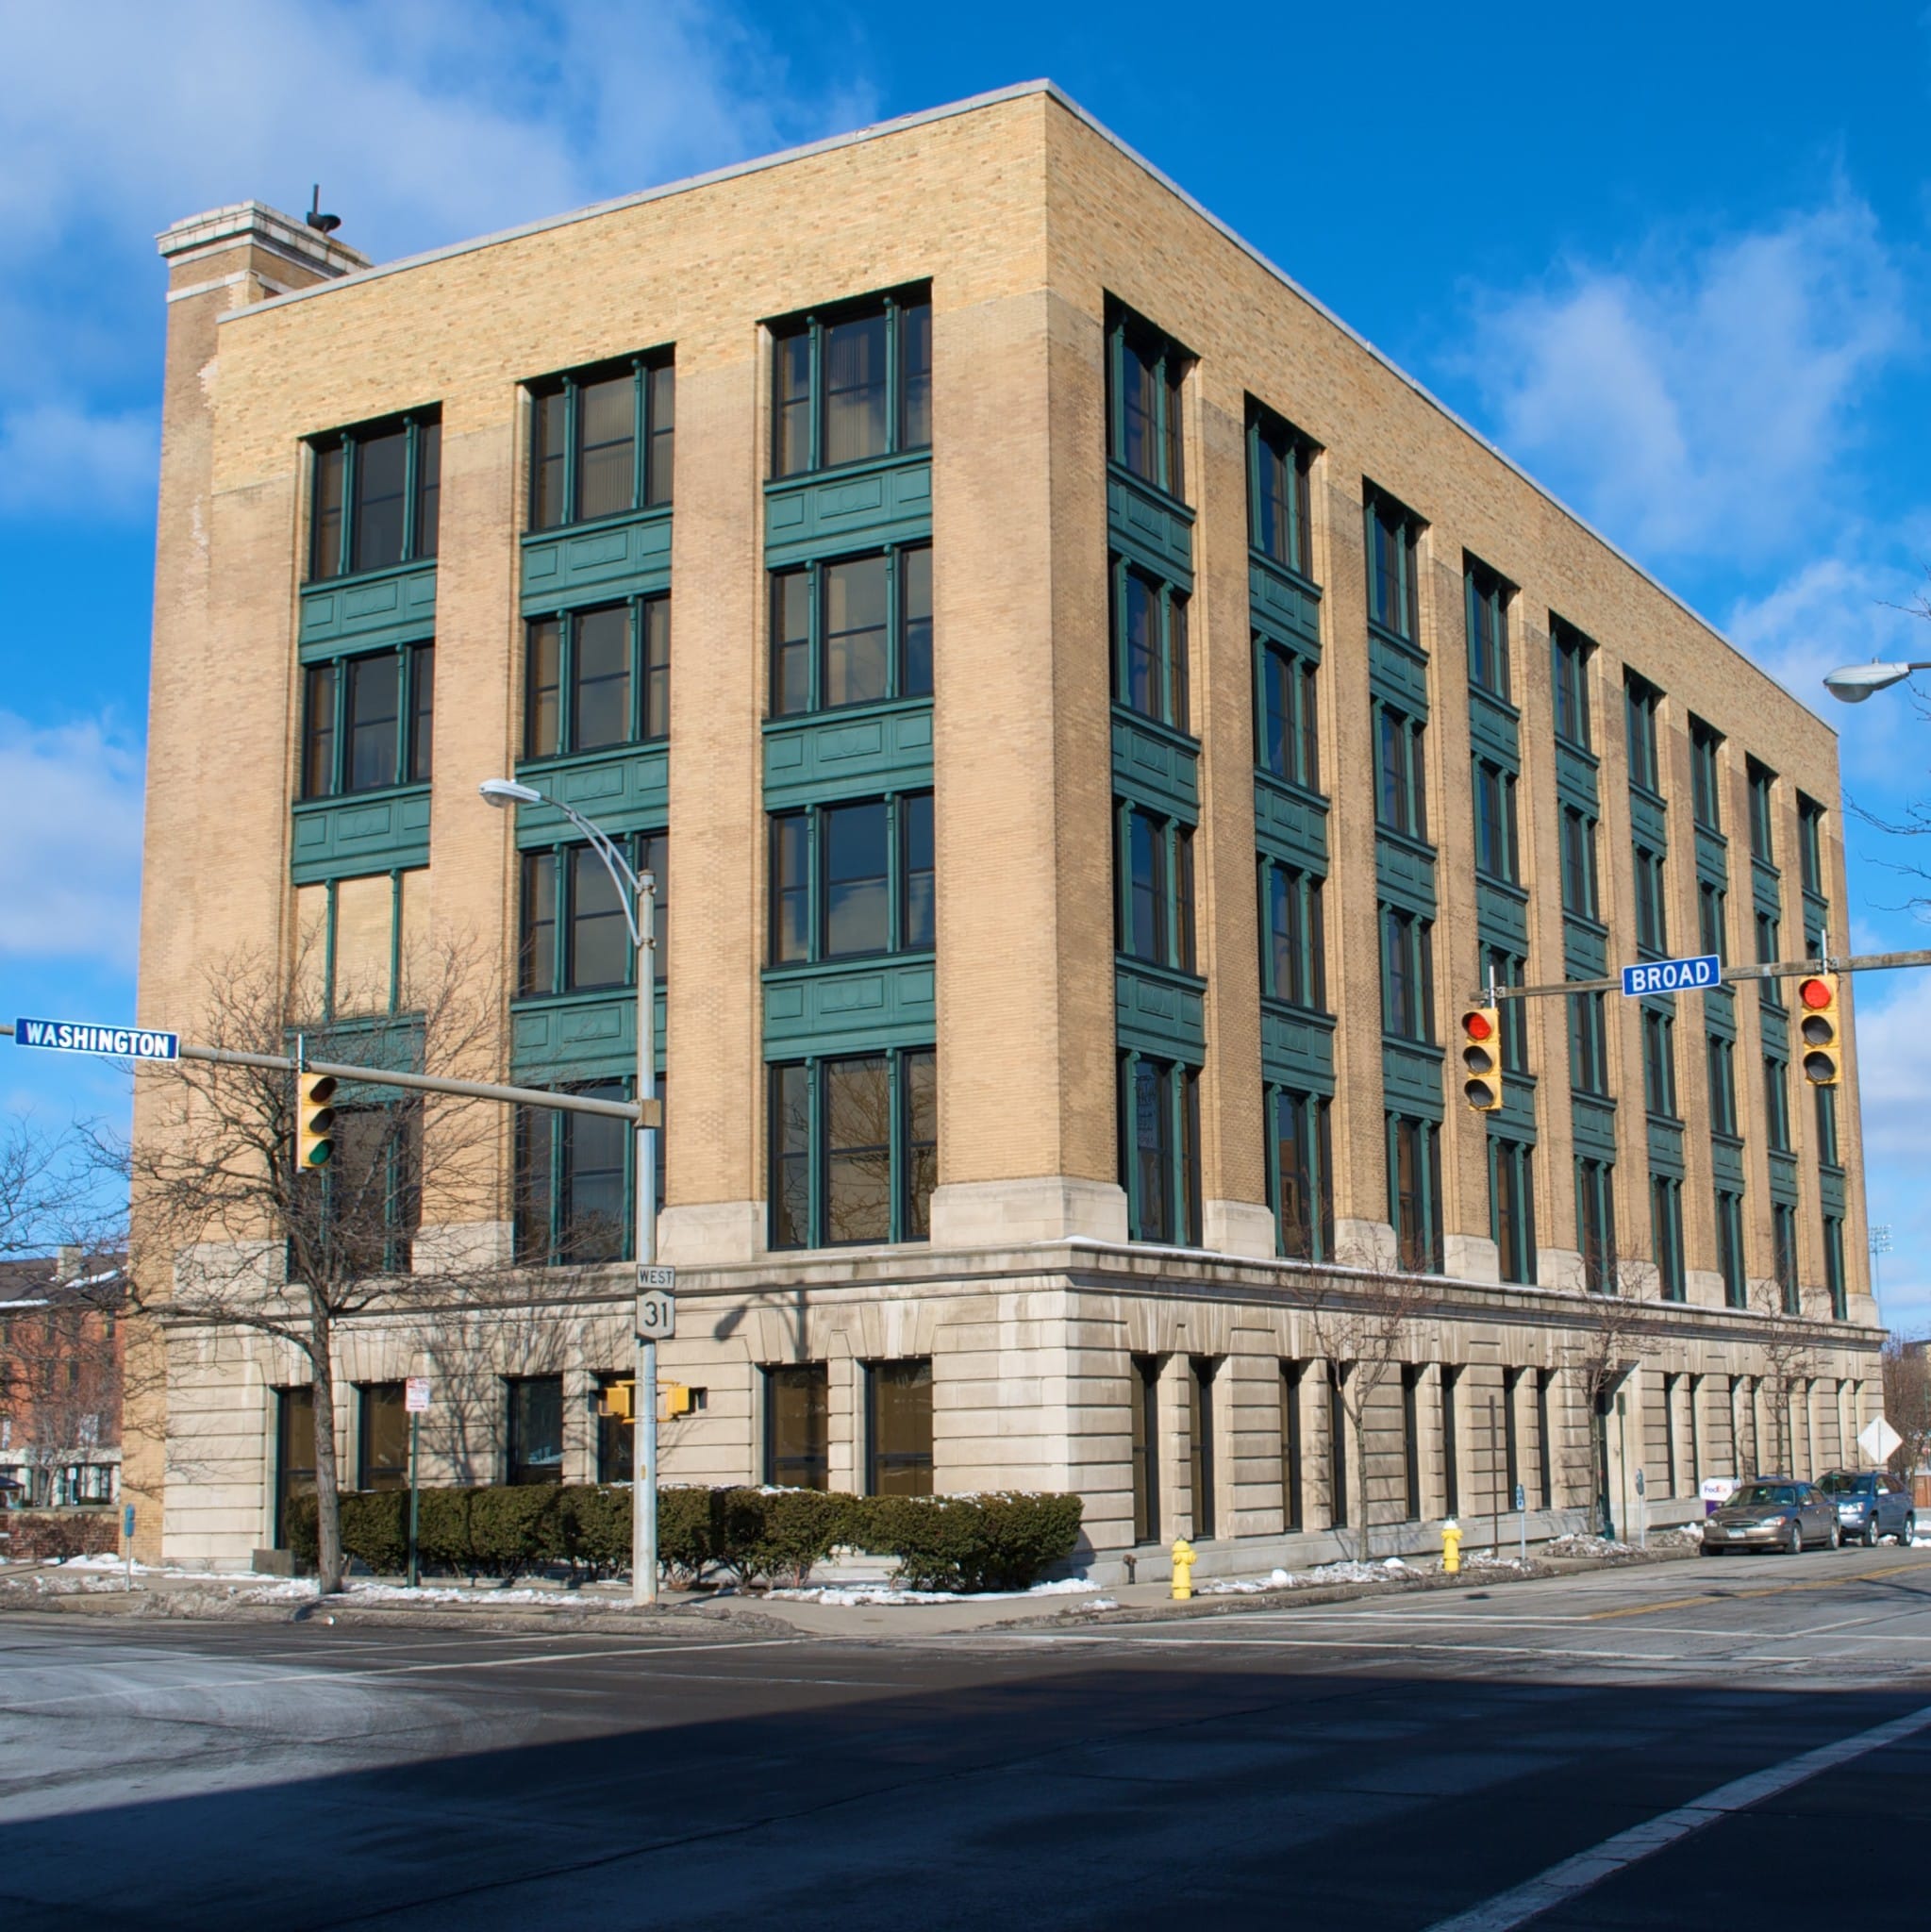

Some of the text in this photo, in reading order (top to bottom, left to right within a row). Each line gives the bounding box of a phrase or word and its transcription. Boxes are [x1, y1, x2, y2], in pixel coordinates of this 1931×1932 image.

[1632, 961, 1710, 991] BROAD
[26, 1022, 168, 1058] WASHINGTON
[640, 1270, 673, 1284] WEST
[644, 1301, 667, 1327] 31
